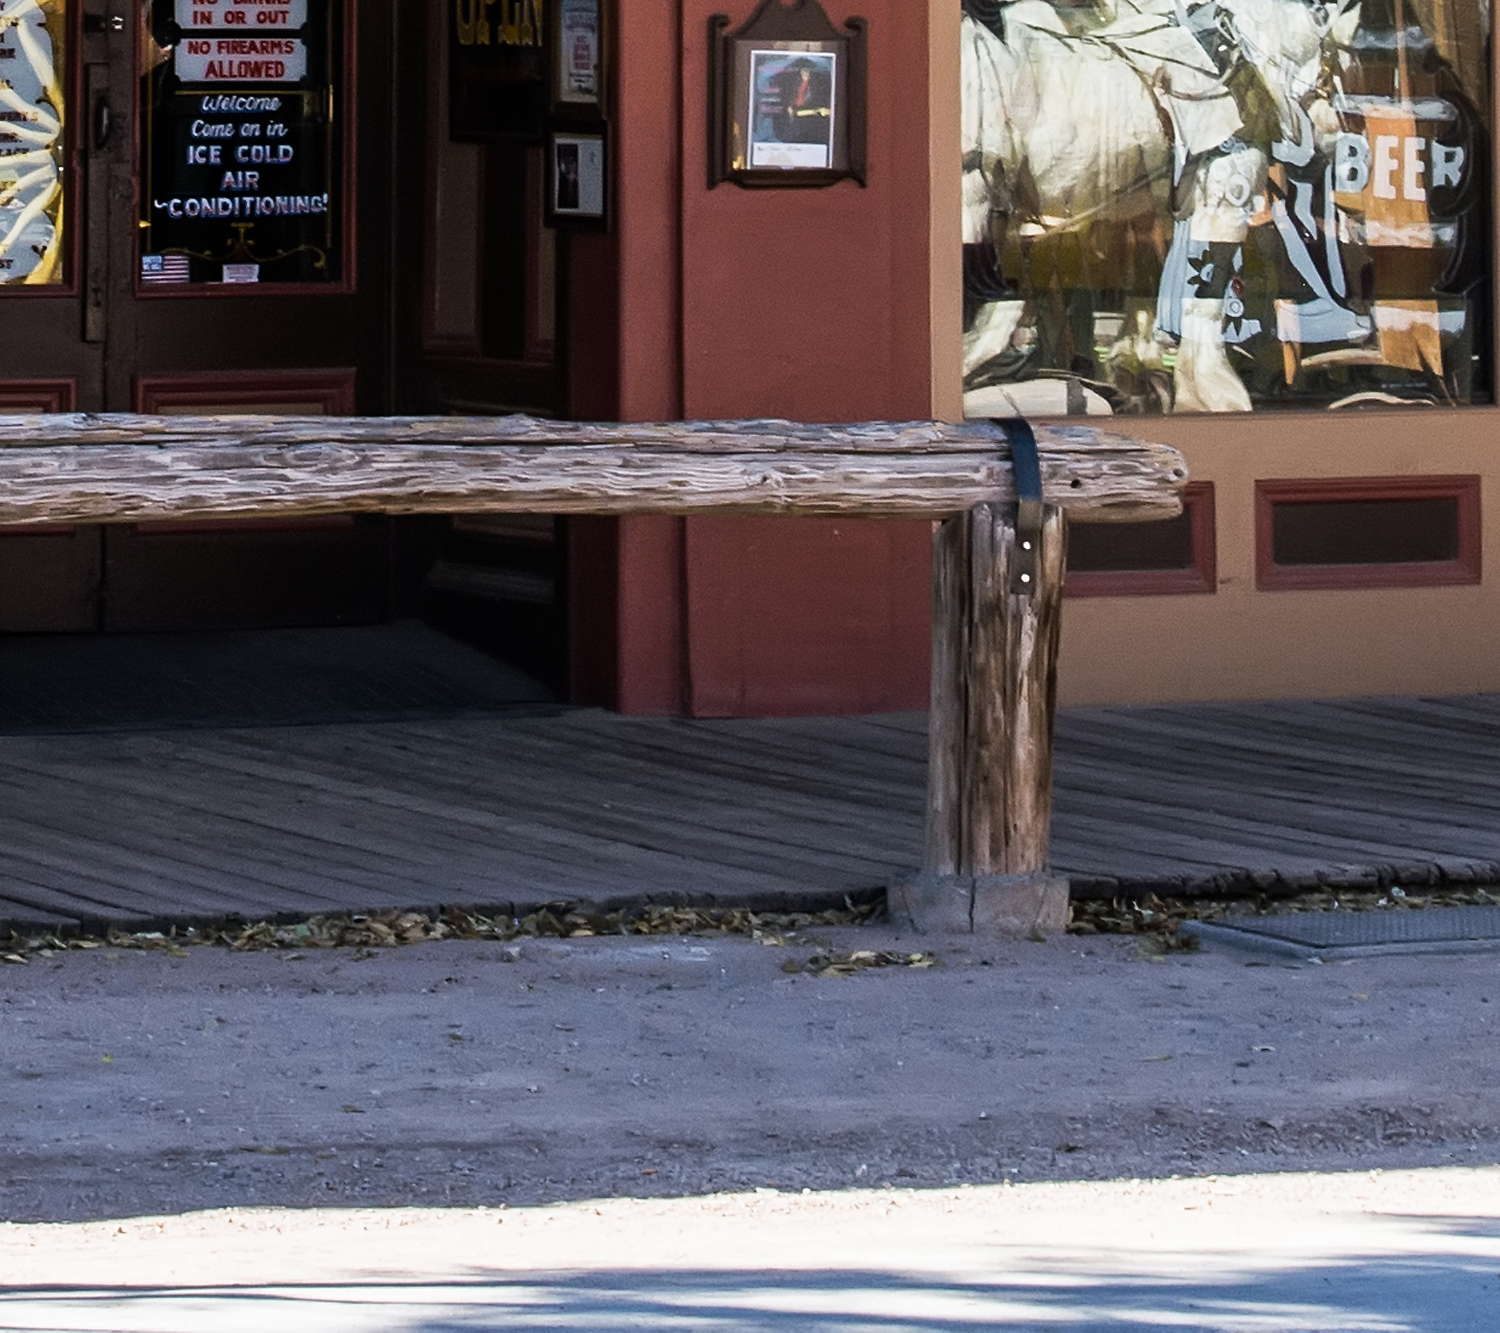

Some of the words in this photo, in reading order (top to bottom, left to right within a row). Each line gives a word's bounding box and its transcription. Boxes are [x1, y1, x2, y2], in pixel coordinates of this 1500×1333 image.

[192, 10, 213, 25] IN
[223, 10, 247, 25] OR
[256, 10, 290, 25] OUT
[187, 39, 212, 56] NO
[216, 39, 295, 56] FIREARMS
[204, 60, 286, 80] ALLOWED
[201, 95, 282, 113] Welcome
[191, 120, 236, 138] Come
[240, 123, 262, 138] on
[266, 121, 289, 138] in
[186, 144, 222, 165] ICE
[234, 144, 295, 164] COLD
[1335, 132, 1465, 202] BEER
[221, 170, 261, 191] AIR
